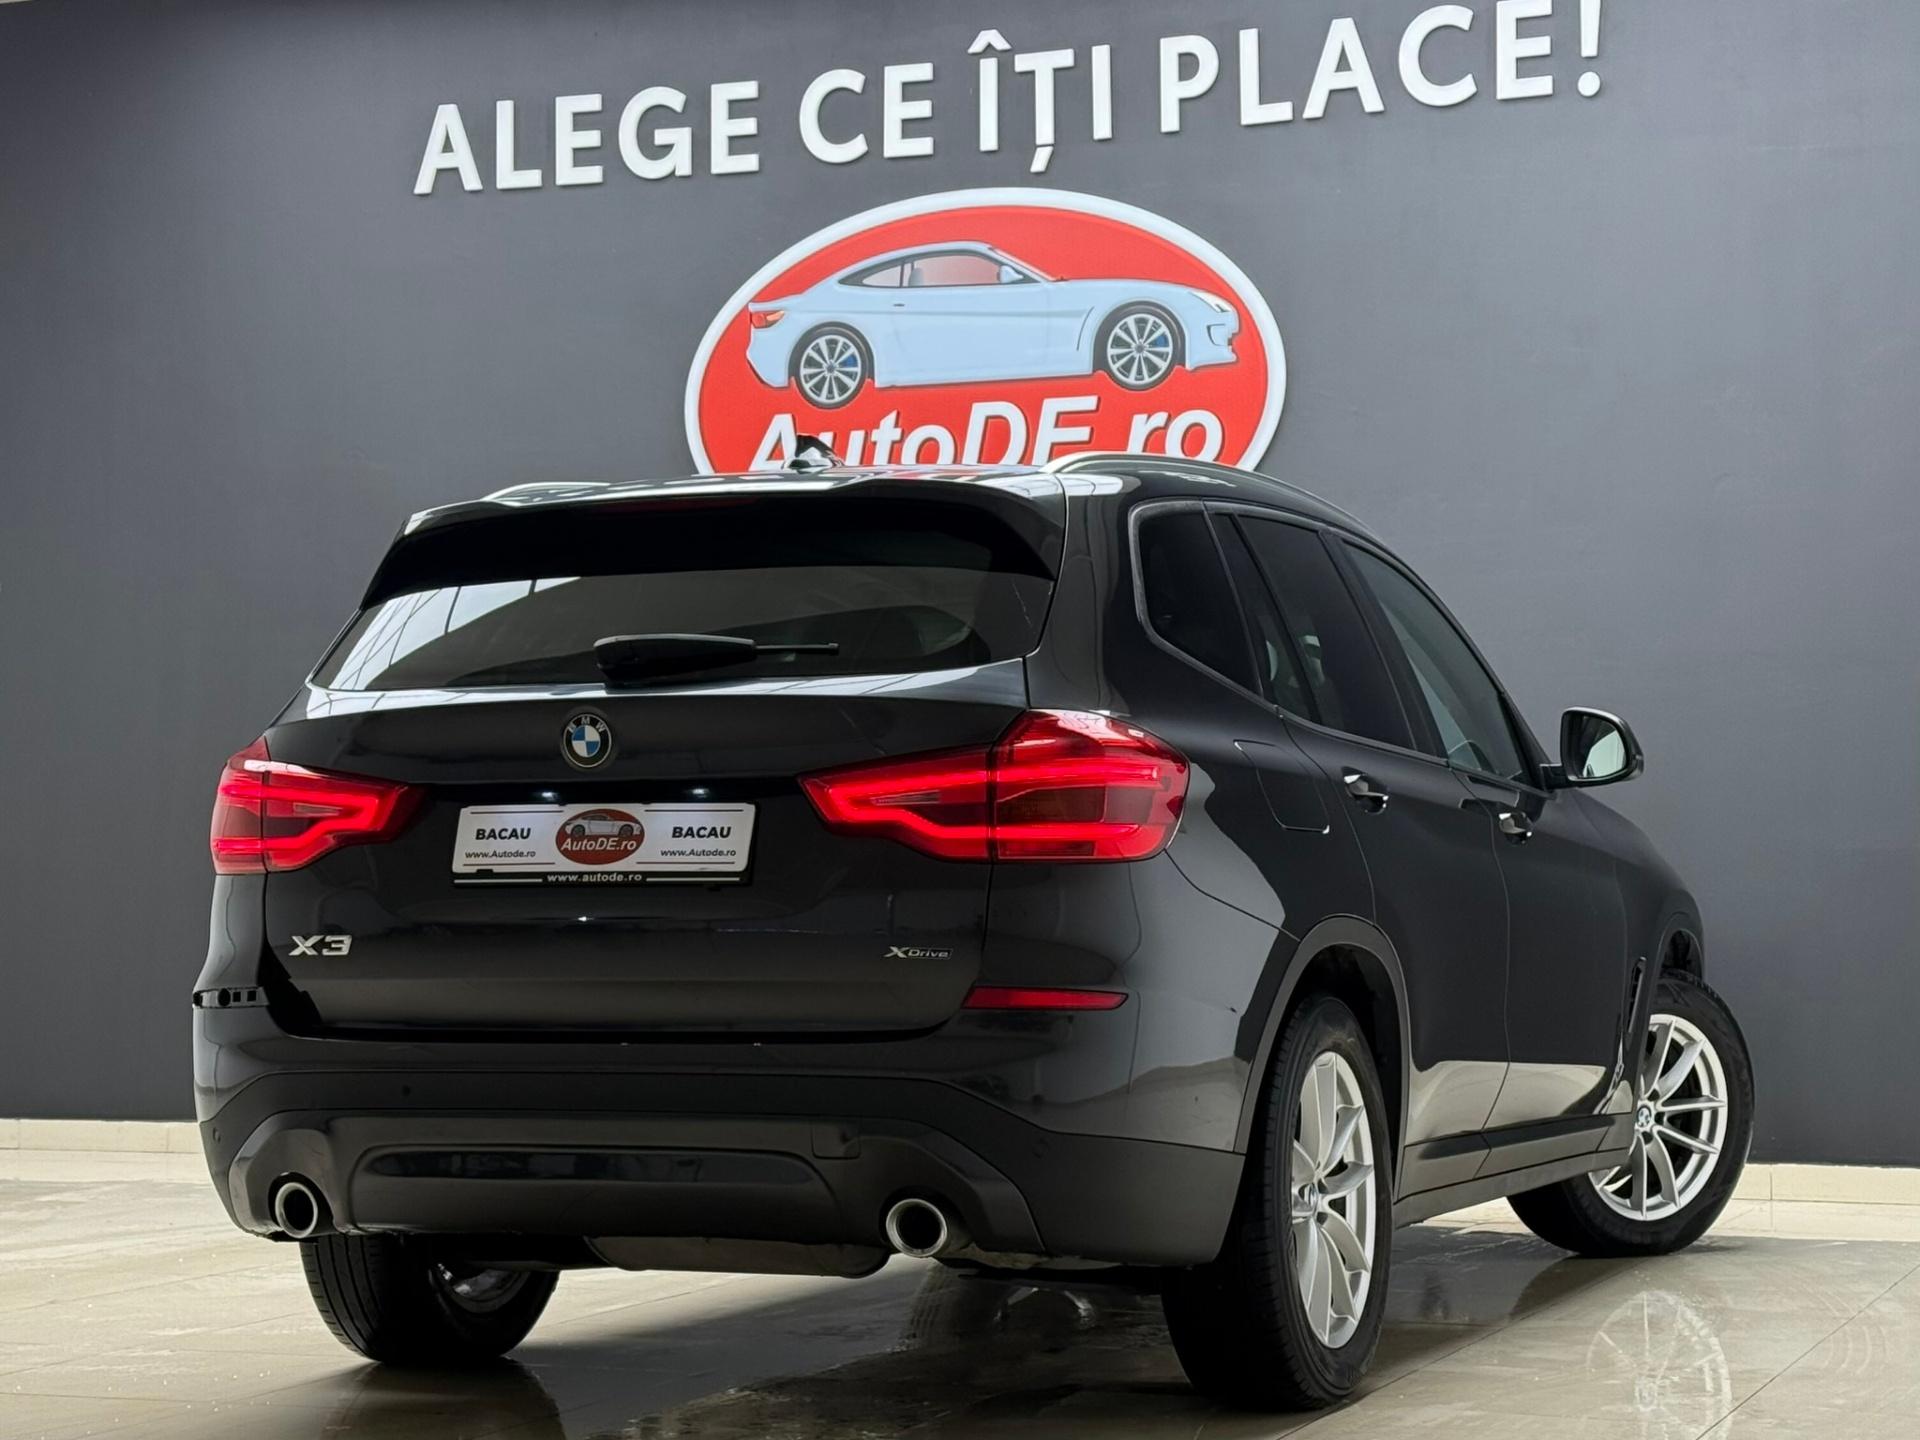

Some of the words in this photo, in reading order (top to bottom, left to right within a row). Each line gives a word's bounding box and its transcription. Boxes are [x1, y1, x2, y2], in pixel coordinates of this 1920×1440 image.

[413, 81, 759, 195] ALEGE
[798, 62, 934, 164] CE
[967, 29, 1113, 173] ÎȚI
[1159, 0, 1602, 134] PLACE!
[475, 827, 532, 841] BACAU
[671, 826, 732, 839] BACAU
[560, 837, 637, 851] AutoDE.ro
[464, 849, 536, 859] www.Autode.ro
[660, 847, 737, 857] www.Autode.ro
[546, 871, 643, 883] www.autode.ro
[288, 934, 353, 956] X3
